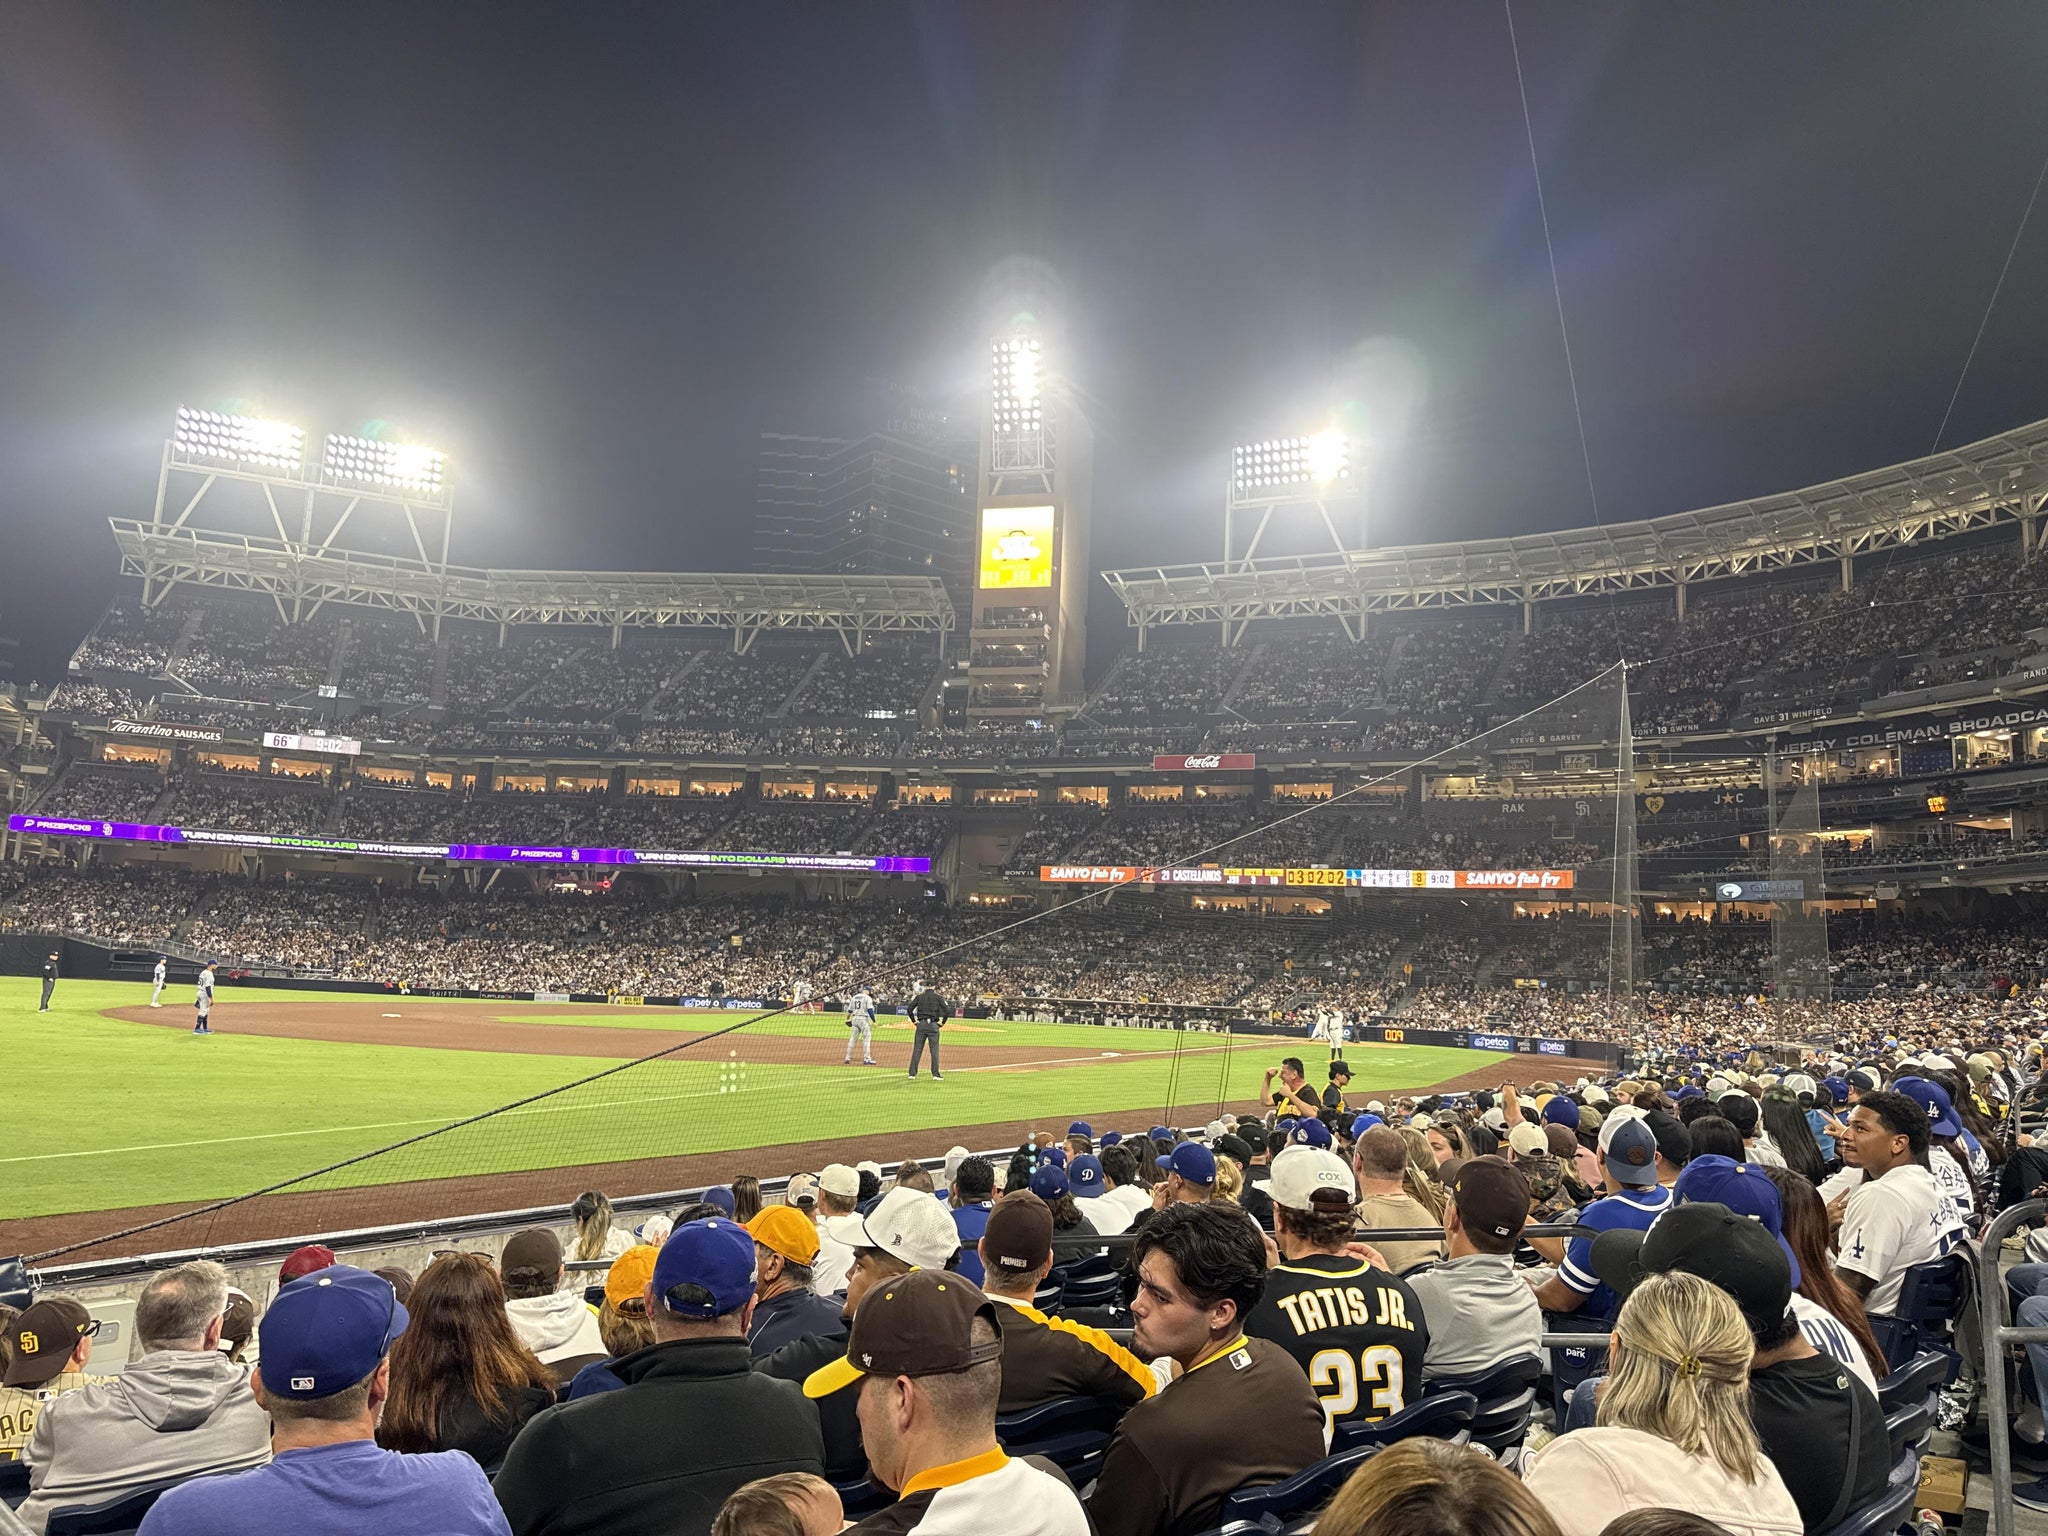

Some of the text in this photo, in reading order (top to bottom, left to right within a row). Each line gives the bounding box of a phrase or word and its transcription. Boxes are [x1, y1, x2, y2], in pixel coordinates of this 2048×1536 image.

[1754, 707, 1833, 724] DAVE 31 WINFIELD
[110, 719, 221, 741] Tarantino SAUSAGES
[1633, 724, 1699, 736] TONY 19 GWYNN
[1846, 725, 1941, 748] COLEMAN
[1550, 734, 1582, 742] GARVEY
[316, 739, 342, 753] 9:02
[1735, 793, 1744, 803] C
[1502, 803, 1525, 813] RAK
[37, 821, 91, 832] PRIZEPICKS
[181, 830, 216, 841] TURN
[272, 836, 301, 846] INTO
[302, 839, 357, 849] DOLLARS
[358, 843, 389, 851] WITH
[634, 852, 664, 860] TURN
[736, 856, 785, 864] DOLLARS
[787, 857, 814, 865] WITH
[814, 858, 876, 867] PRIZEPICKS
[1050, 867, 1126, 882] SANYO fish fry
[1173, 869, 1222, 881] CASTELLANOS
[1297, 870, 1304, 884] 3
[1316, 870, 1324, 884] 2
[1337, 870, 1344, 884] 2
[1416, 872, 1422, 883] 8
[1431, 874, 1450, 884] 9:02
[1466, 872, 1561, 888] SANYO fish fry
[737, 1000, 762, 1009] petco
[854, 1000, 861, 1010] 13
[1484, 1038, 1509, 1048] petco
[1547, 1042, 1566, 1052] petco
[1928, 1101, 1939, 1118] LA
[1082, 1168, 1094, 1182] D
[1318, 1172, 1341, 1182] COX
[1277, 1287, 1415, 1336] TATIS JR.
[20, 1331, 39, 1354] SD
[1566, 1347, 1586, 1359] park
[1309, 1344, 1405, 1450] 23
